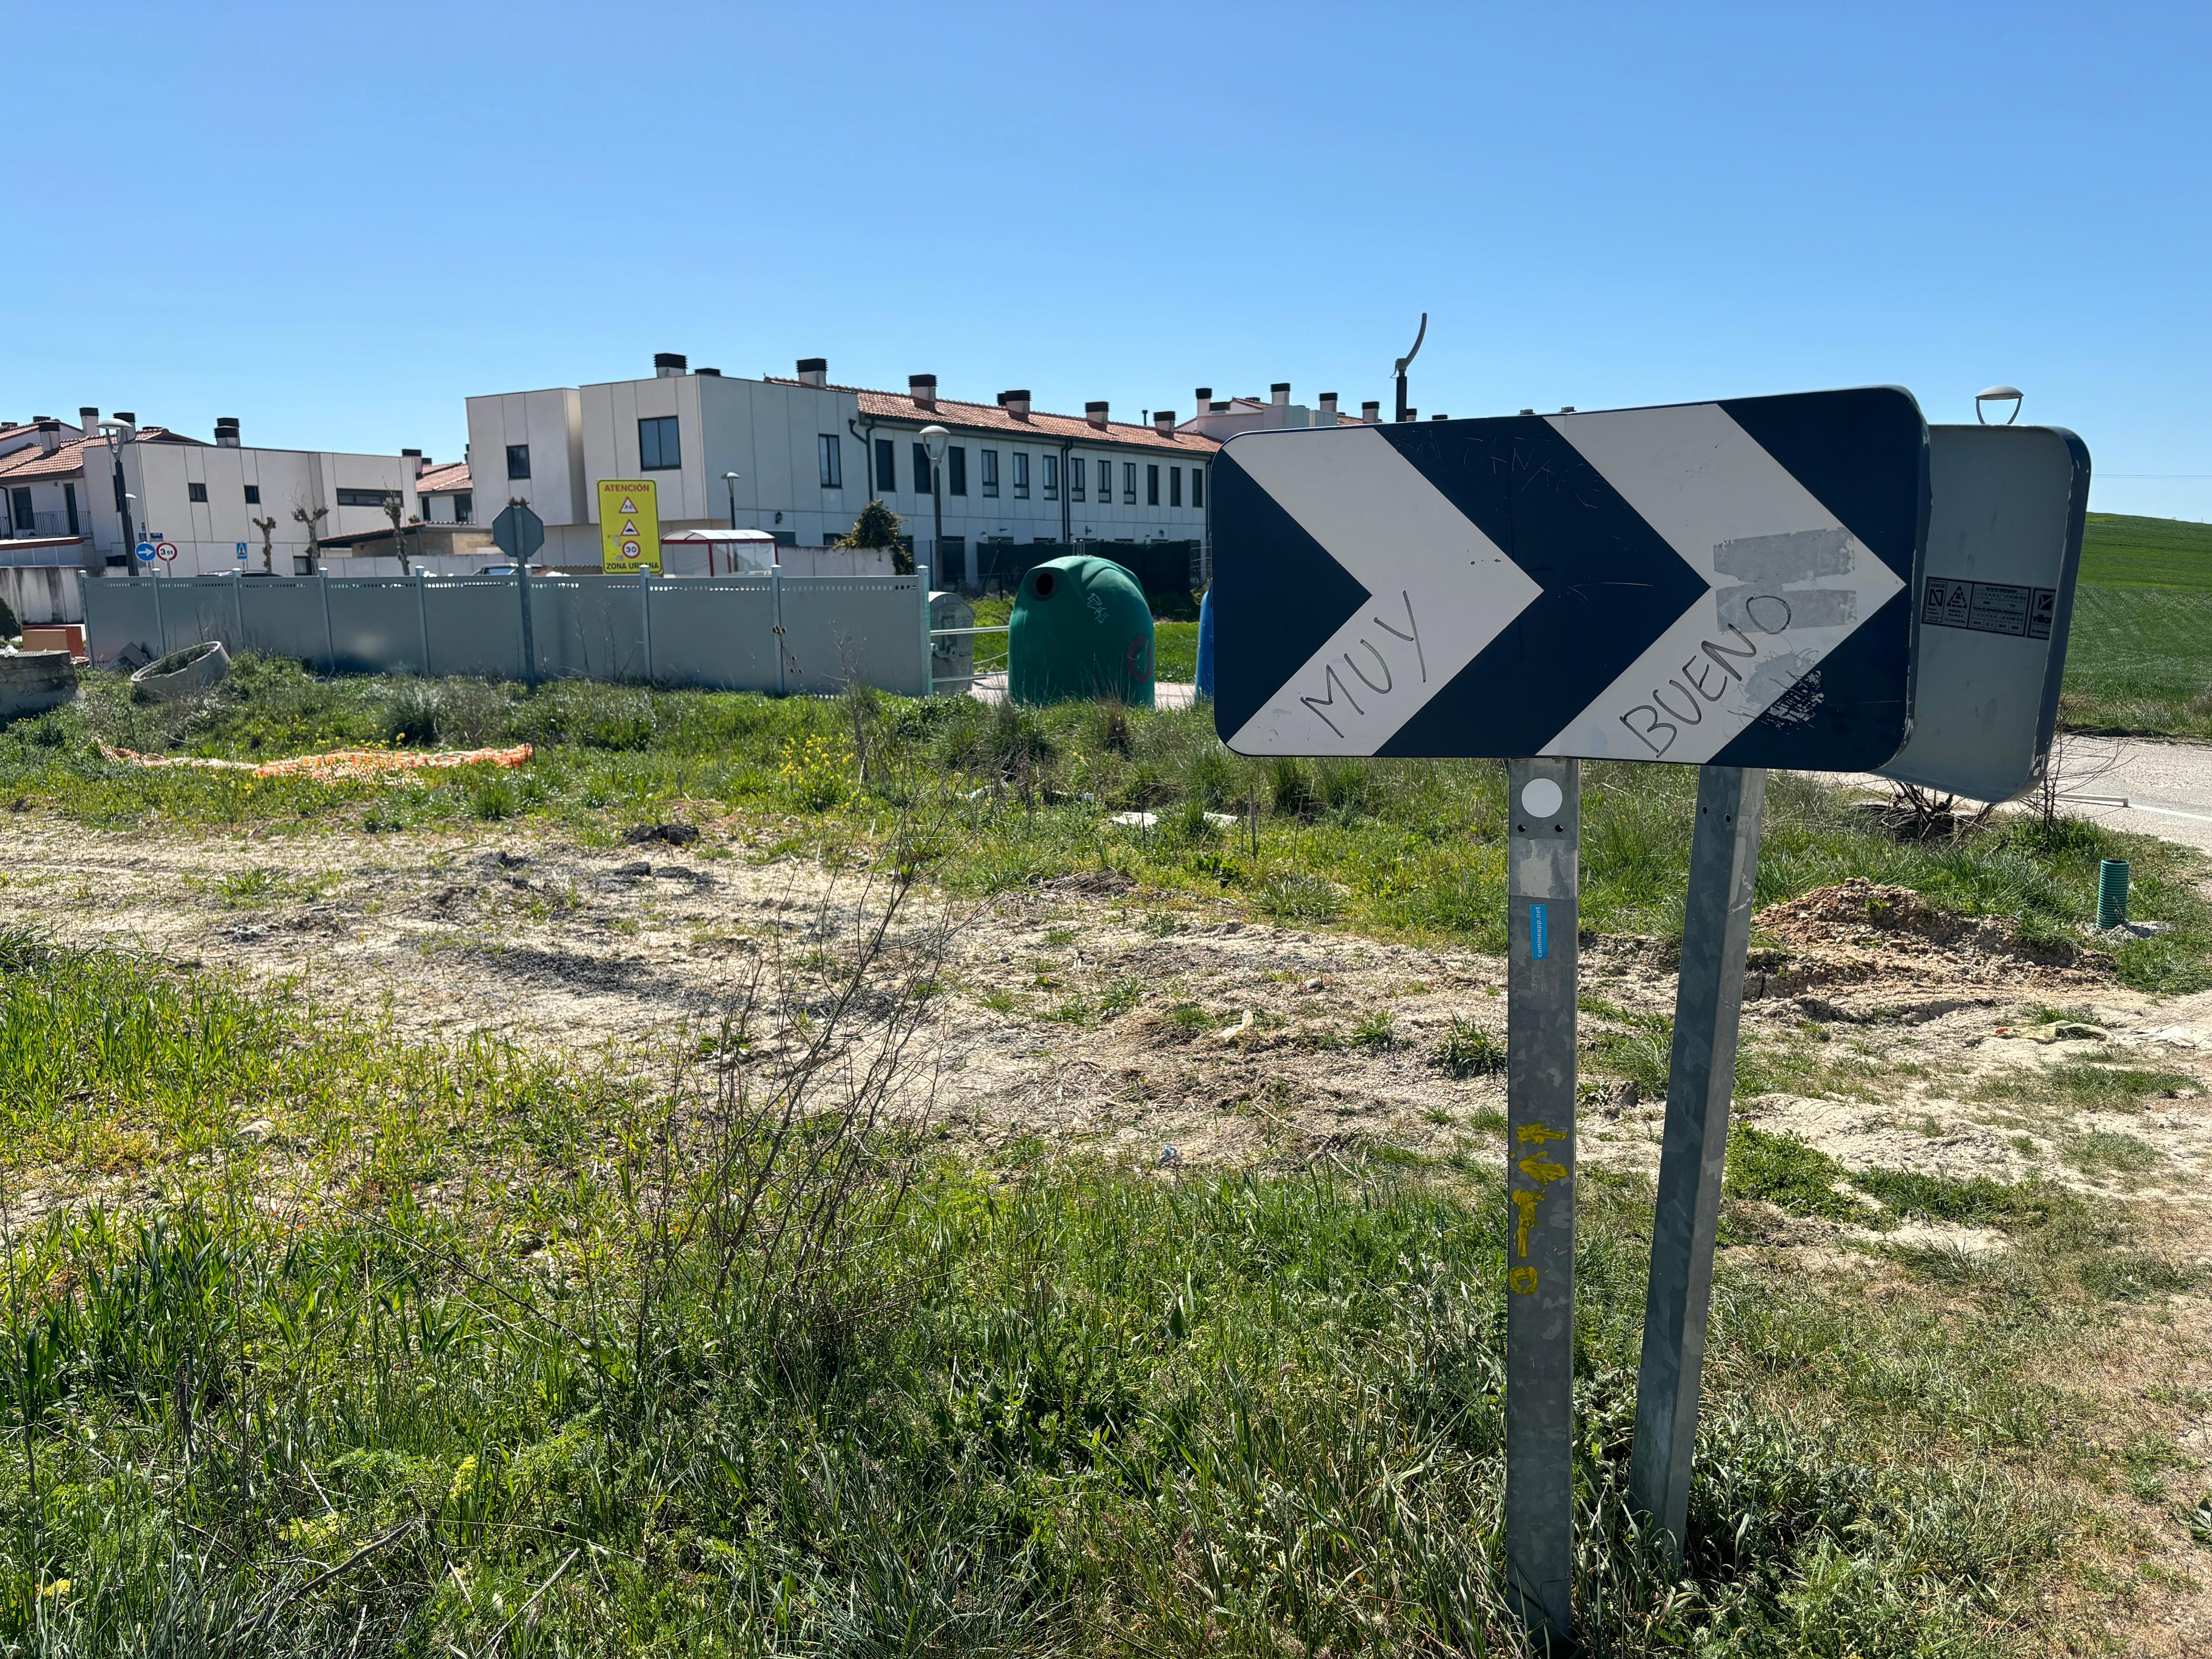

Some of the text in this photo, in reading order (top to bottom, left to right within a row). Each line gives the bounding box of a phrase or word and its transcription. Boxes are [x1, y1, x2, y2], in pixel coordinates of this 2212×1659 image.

[604, 484, 650, 492] ATENCIÓN
[1300, 589, 1427, 739] MUY
[1619, 595, 1791, 759] BUENO
